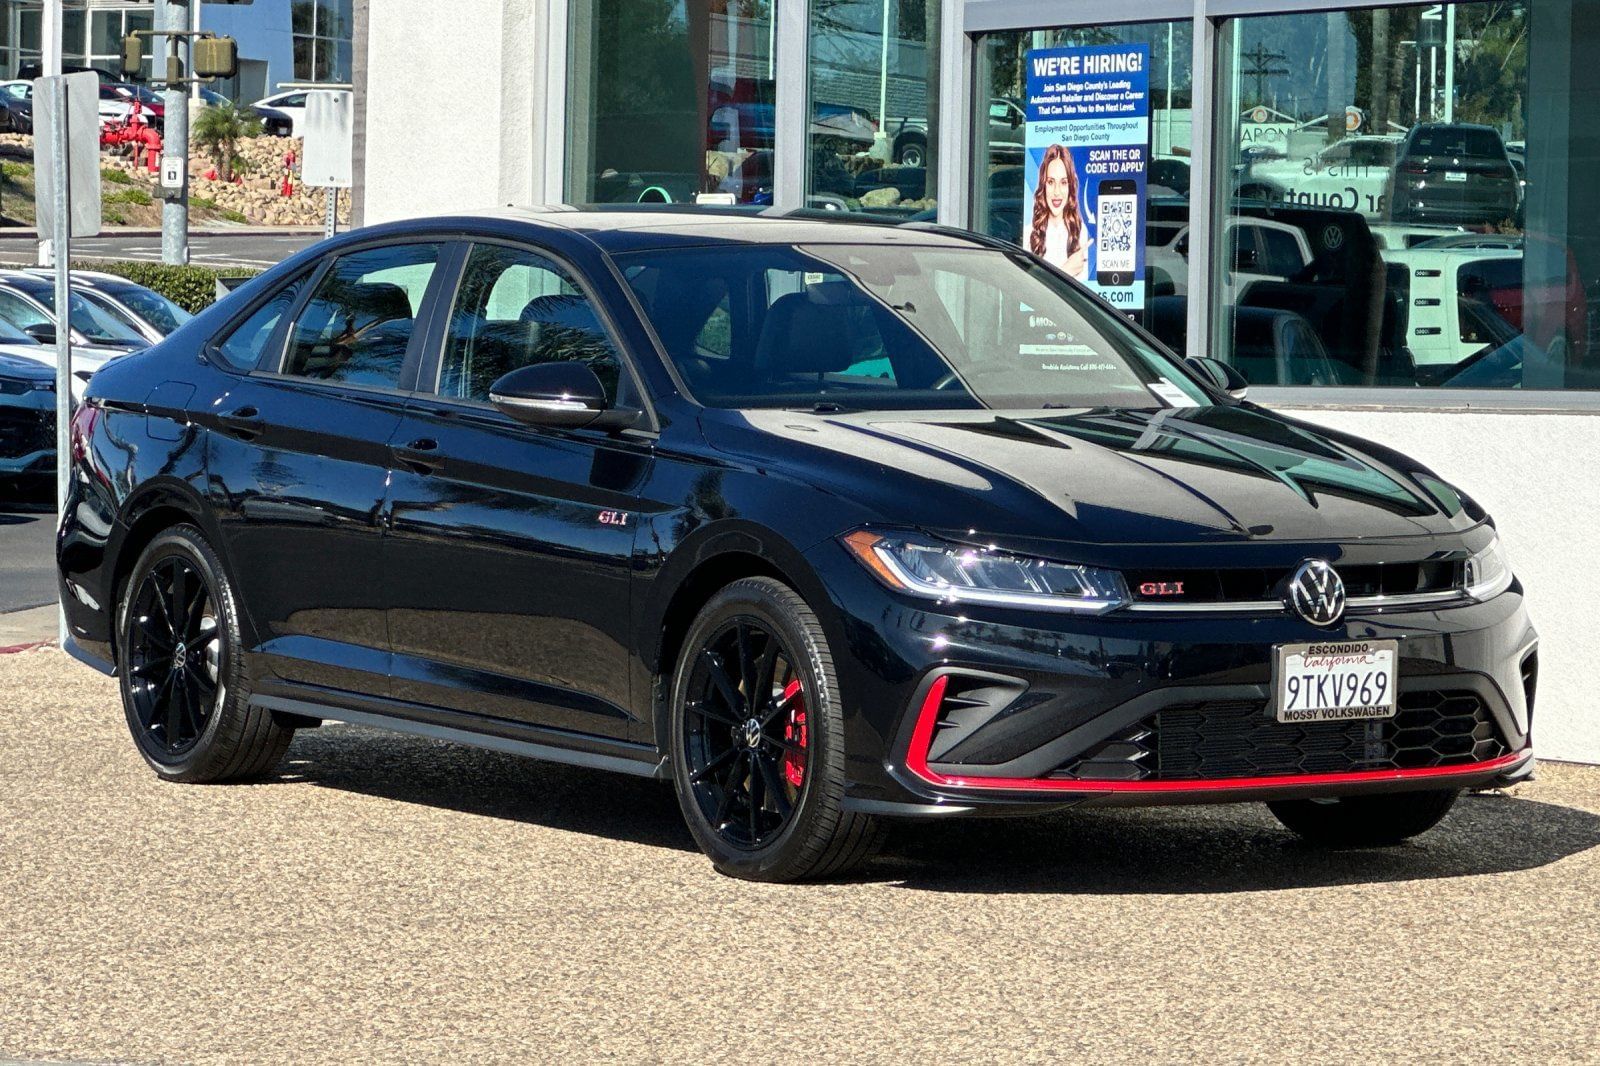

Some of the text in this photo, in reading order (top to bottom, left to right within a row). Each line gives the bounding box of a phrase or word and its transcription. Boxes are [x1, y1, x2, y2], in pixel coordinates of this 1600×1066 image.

[1033, 53, 1143, 77] WE'RE HIRING!
[1043, 80, 1131, 92] Join San Diego County's Leading
[1030, 95, 1061, 104] Automotive
[1062, 93, 1083, 103] Retailer
[1084, 93, 1095, 102] and
[1095, 92, 1119, 101] Discover
[1124, 91, 1144, 100] Career
[1038, 106, 1050, 115] That
[1051, 106, 1062, 114] Can
[1063, 105, 1076, 114] Take
[1077, 104, 1087, 113] You
[1088, 104, 1095, 113] to
[1095, 104, 1105, 112] the
[1105, 103, 1119, 112] Next
[1034, 121, 1138, 134] Employment Opportunities Throughout
[1061, 132, 1110, 142] San Diego County
[1089, 149, 1111, 161] SCAN
[1112, 149, 1128, 160] THE
[1085, 161, 1144, 174] CODE TO APPLY
[1102, 259, 1130, 269] SCAN ME
[598, 510, 628, 526] GLI
[1140, 581, 1184, 595] GLI
[1308, 643, 1369, 655] ESCONDIDO
[1303, 655, 1375, 672] California
[1287, 671, 1388, 710] 9TKV969
[1284, 706, 1390, 721] MOSSY VOLKSWAGEN
